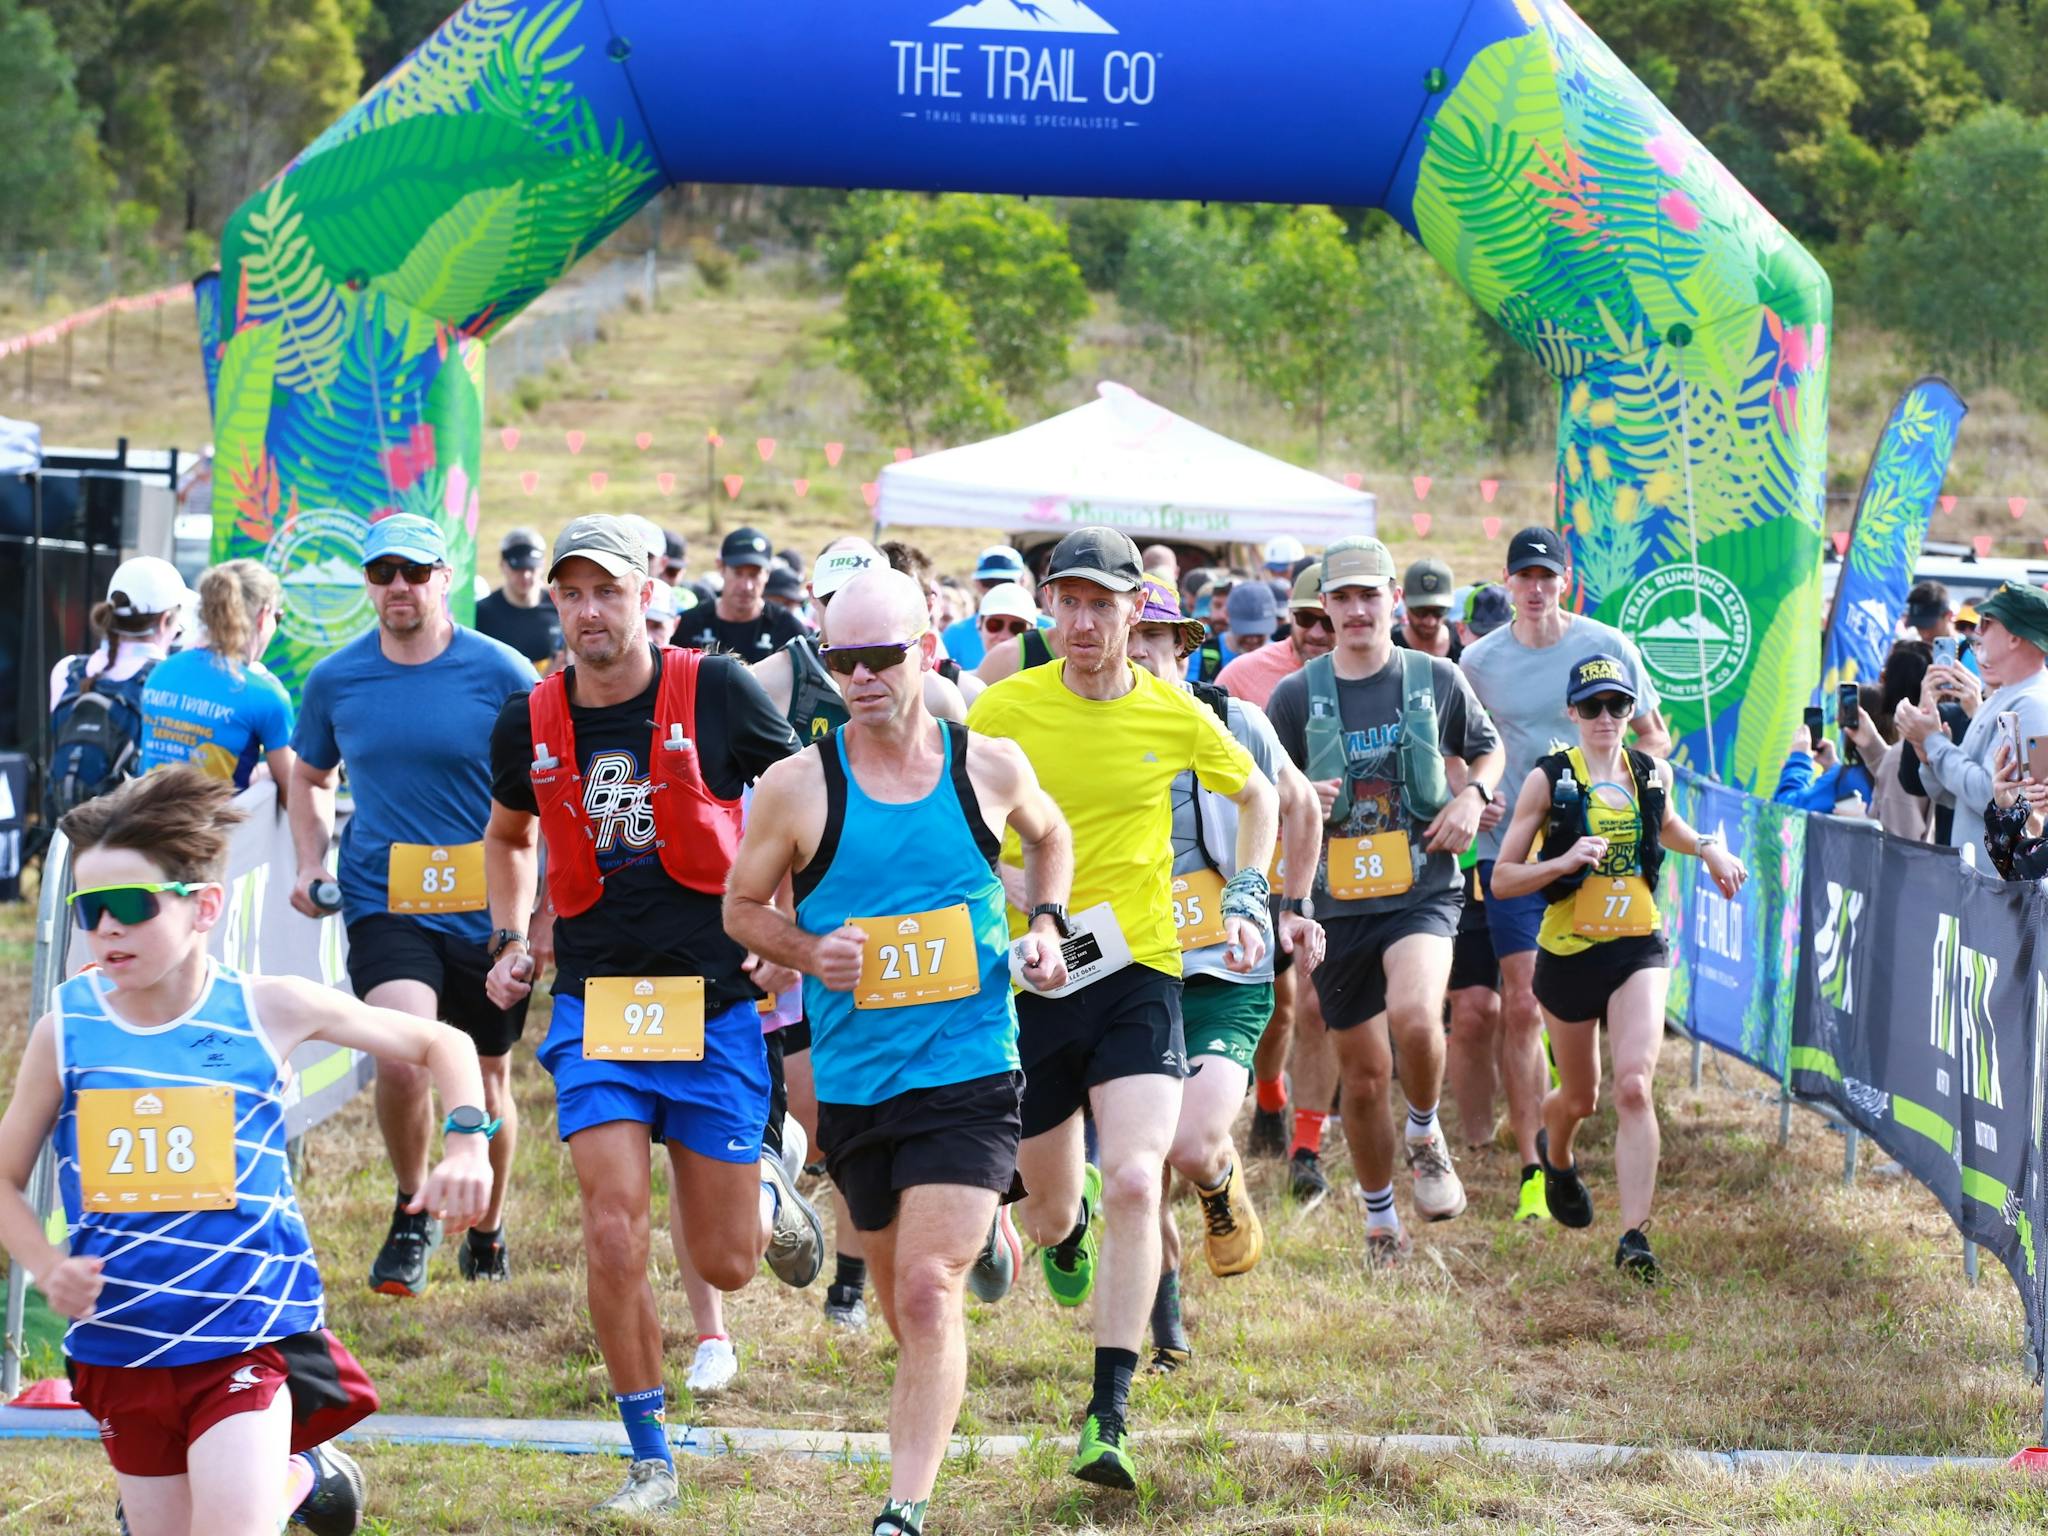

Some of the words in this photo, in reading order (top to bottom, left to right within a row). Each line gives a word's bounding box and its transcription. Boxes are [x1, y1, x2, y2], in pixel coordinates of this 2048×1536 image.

[889, 40, 964, 98] THE
[979, 45, 1088, 103] TRAIL
[1103, 50, 1156, 105] CO
[925, 110, 962, 124] TRAIL
[970, 112, 1027, 127] RUNNING
[1034, 115, 1119, 131] SPECIALISTS
[1624, 585, 1655, 626] TRAIL
[1654, 570, 1727, 595] RUNNING
[1723, 592, 1746, 665] EXPERTS
[422, 866, 456, 894] 85
[1354, 854, 1383, 880] 58
[1603, 895, 1632, 918] 77
[879, 938, 946, 980] 217
[624, 1003, 664, 1035] 92
[107, 1126, 196, 1174] 218
